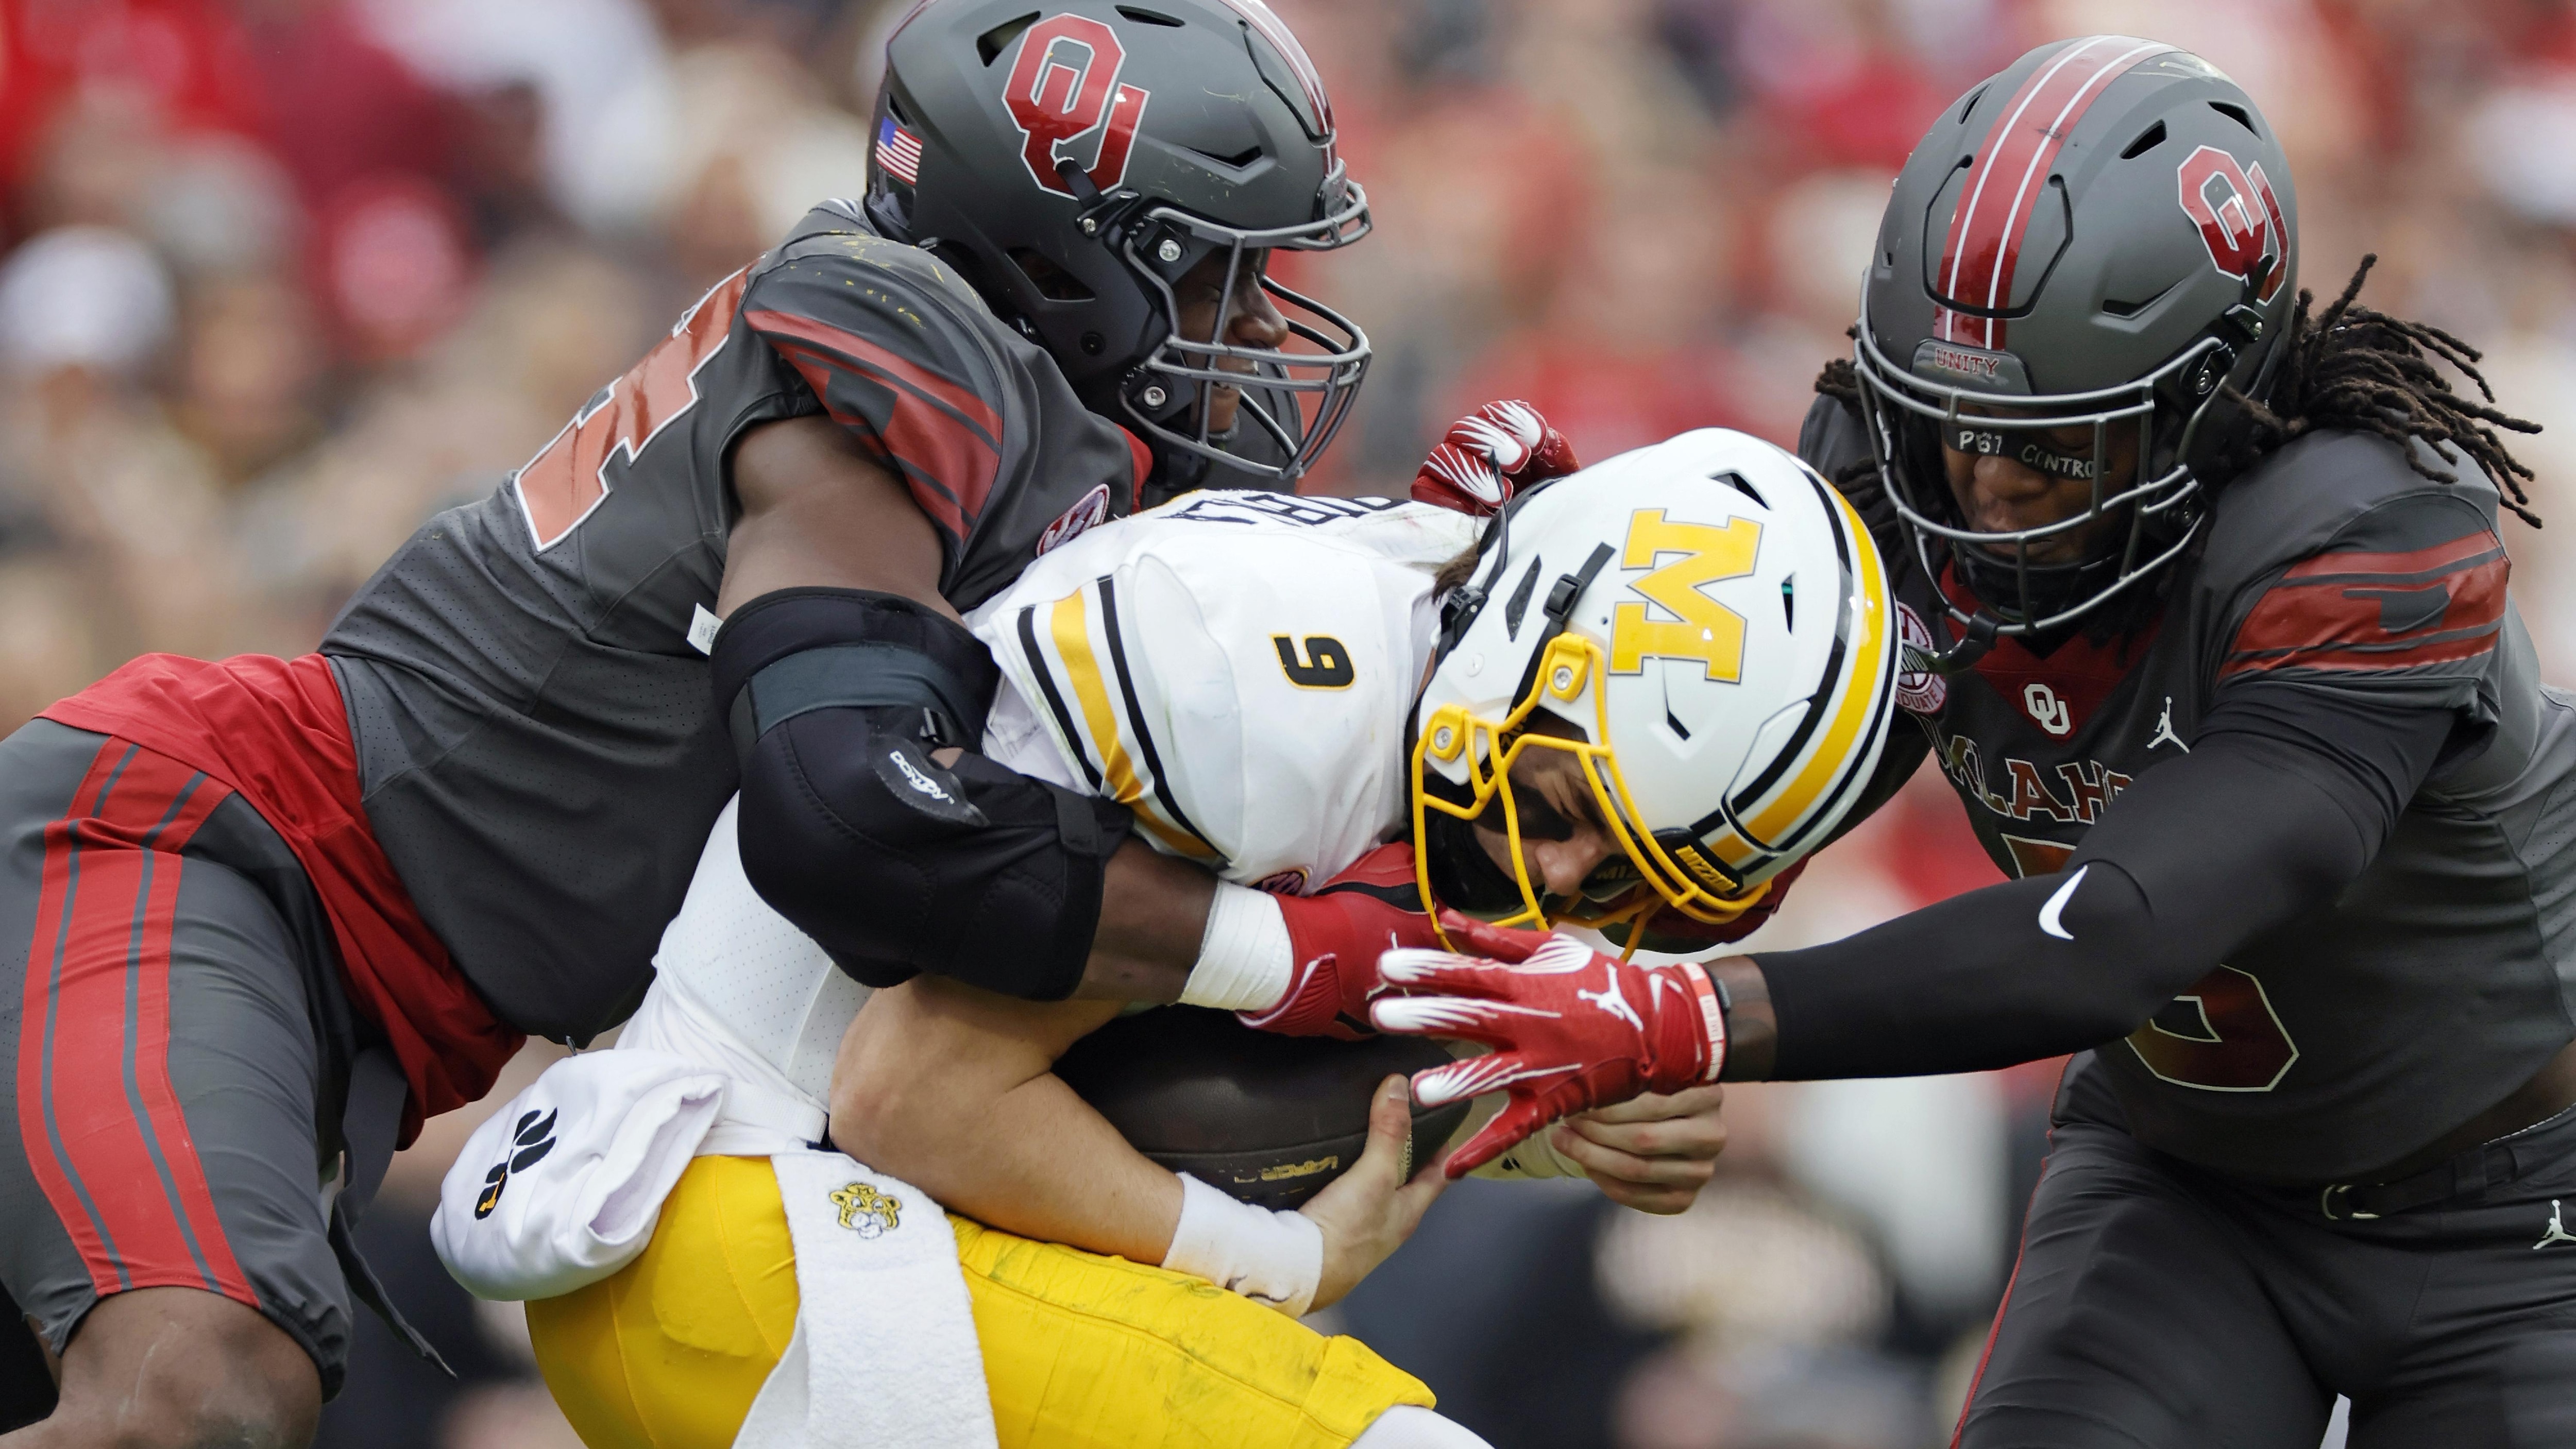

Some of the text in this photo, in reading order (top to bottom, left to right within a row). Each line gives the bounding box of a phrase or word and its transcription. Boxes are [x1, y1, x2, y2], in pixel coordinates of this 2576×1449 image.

[1002, 12, 1150, 201] OU
[2177, 145, 2290, 306] OU
[1935, 347, 1999, 377] UNITY
[2021, 444, 2111, 479] CONTRO
[1608, 507, 1764, 685] M
[1269, 633, 1357, 691] 9
[1896, 689, 1941, 709] DUATE
[2023, 684, 2072, 735] OU
[1919, 715, 2133, 825] OKLAH
